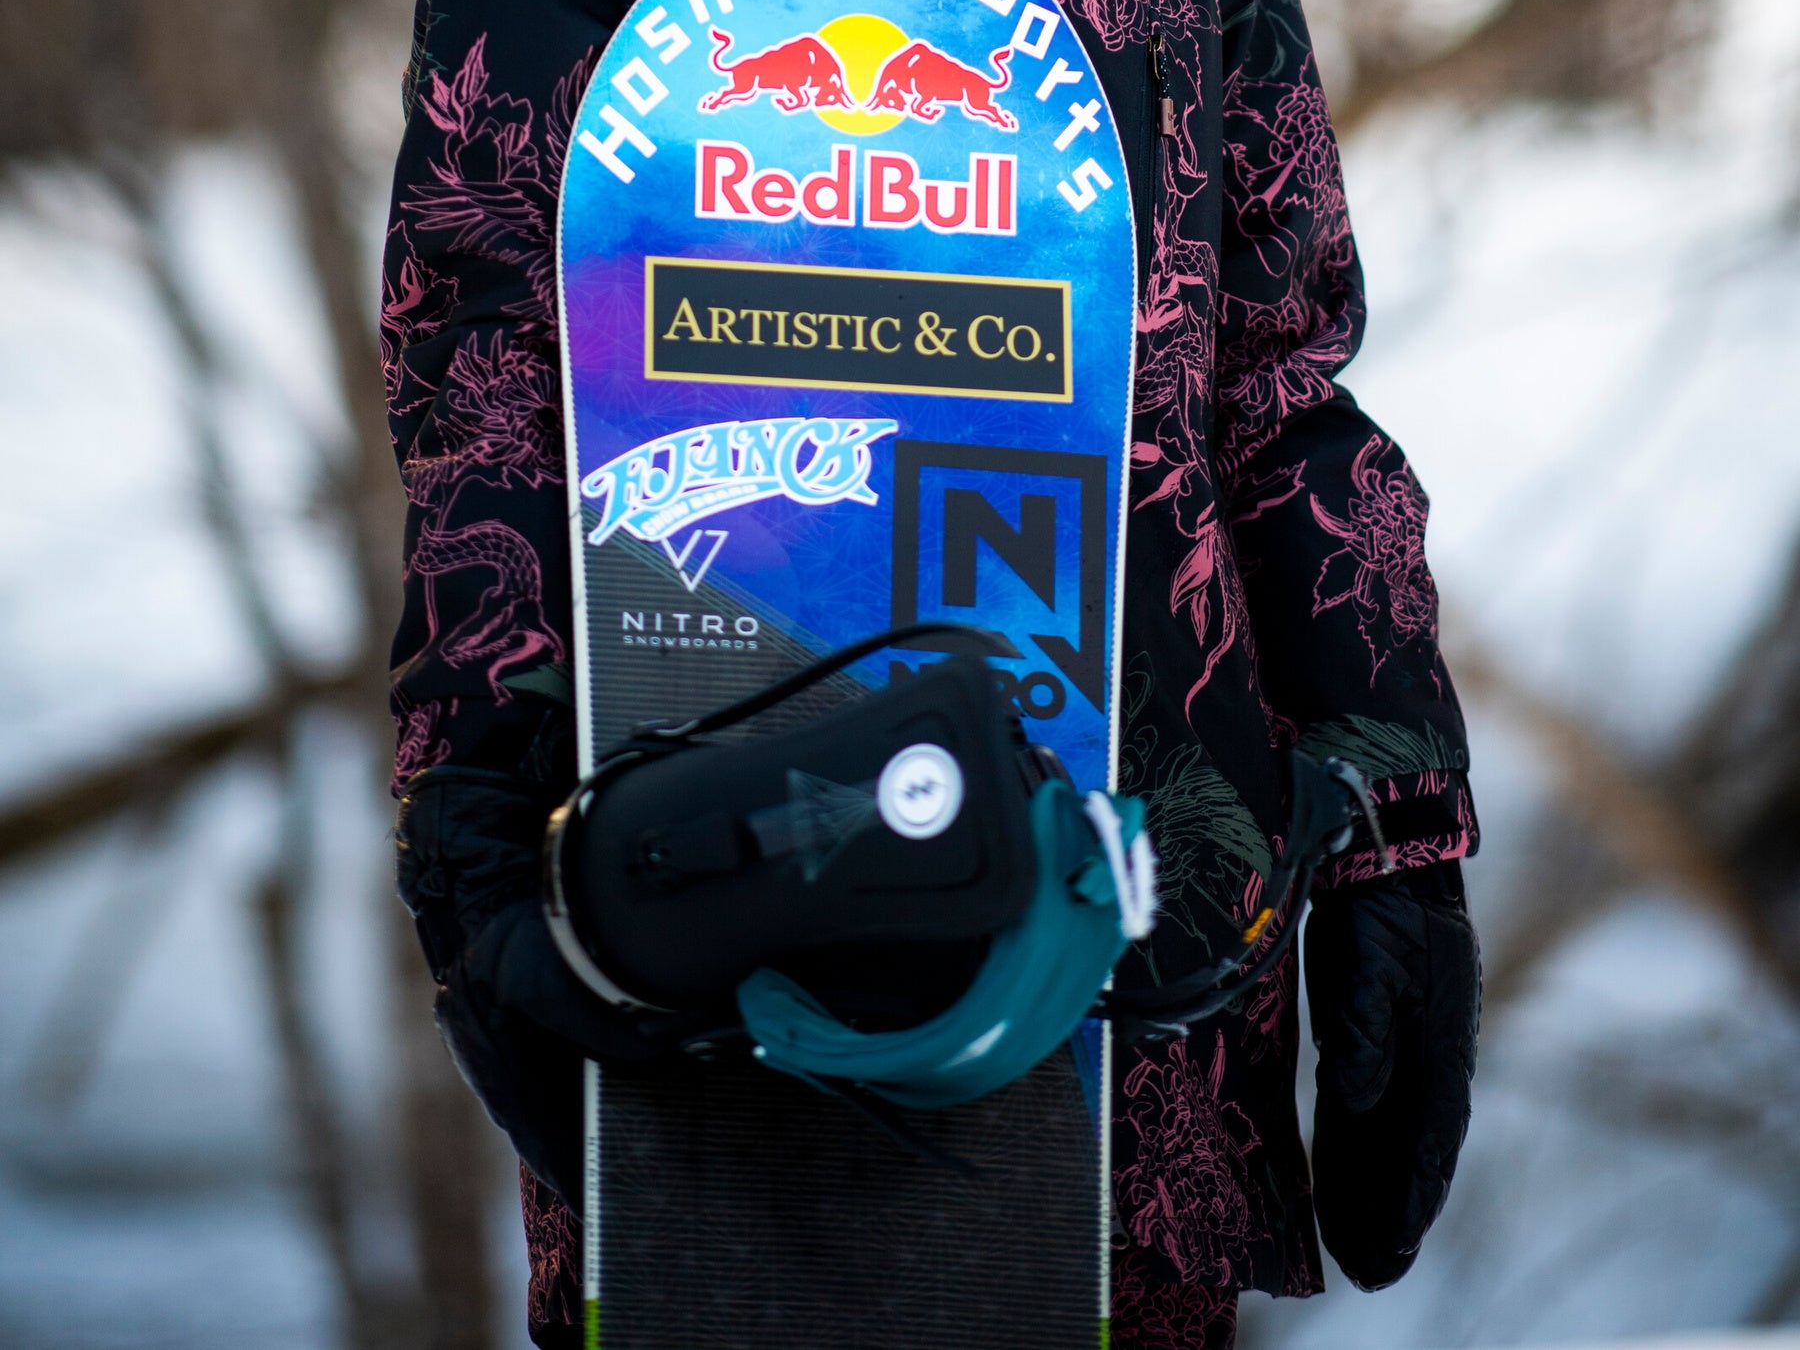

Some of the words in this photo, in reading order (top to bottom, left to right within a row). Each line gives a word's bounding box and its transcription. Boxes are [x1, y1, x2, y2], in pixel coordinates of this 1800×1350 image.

[702, 144, 850, 220] Red
[869, 155, 1012, 231] Bull
[662, 297, 900, 352] ARTISTIC
[914, 310, 956, 357] &
[966, 314, 1056, 362] CO.
[622, 611, 759, 637] NITRO
[622, 635, 759, 650] SNOWBOARDS
